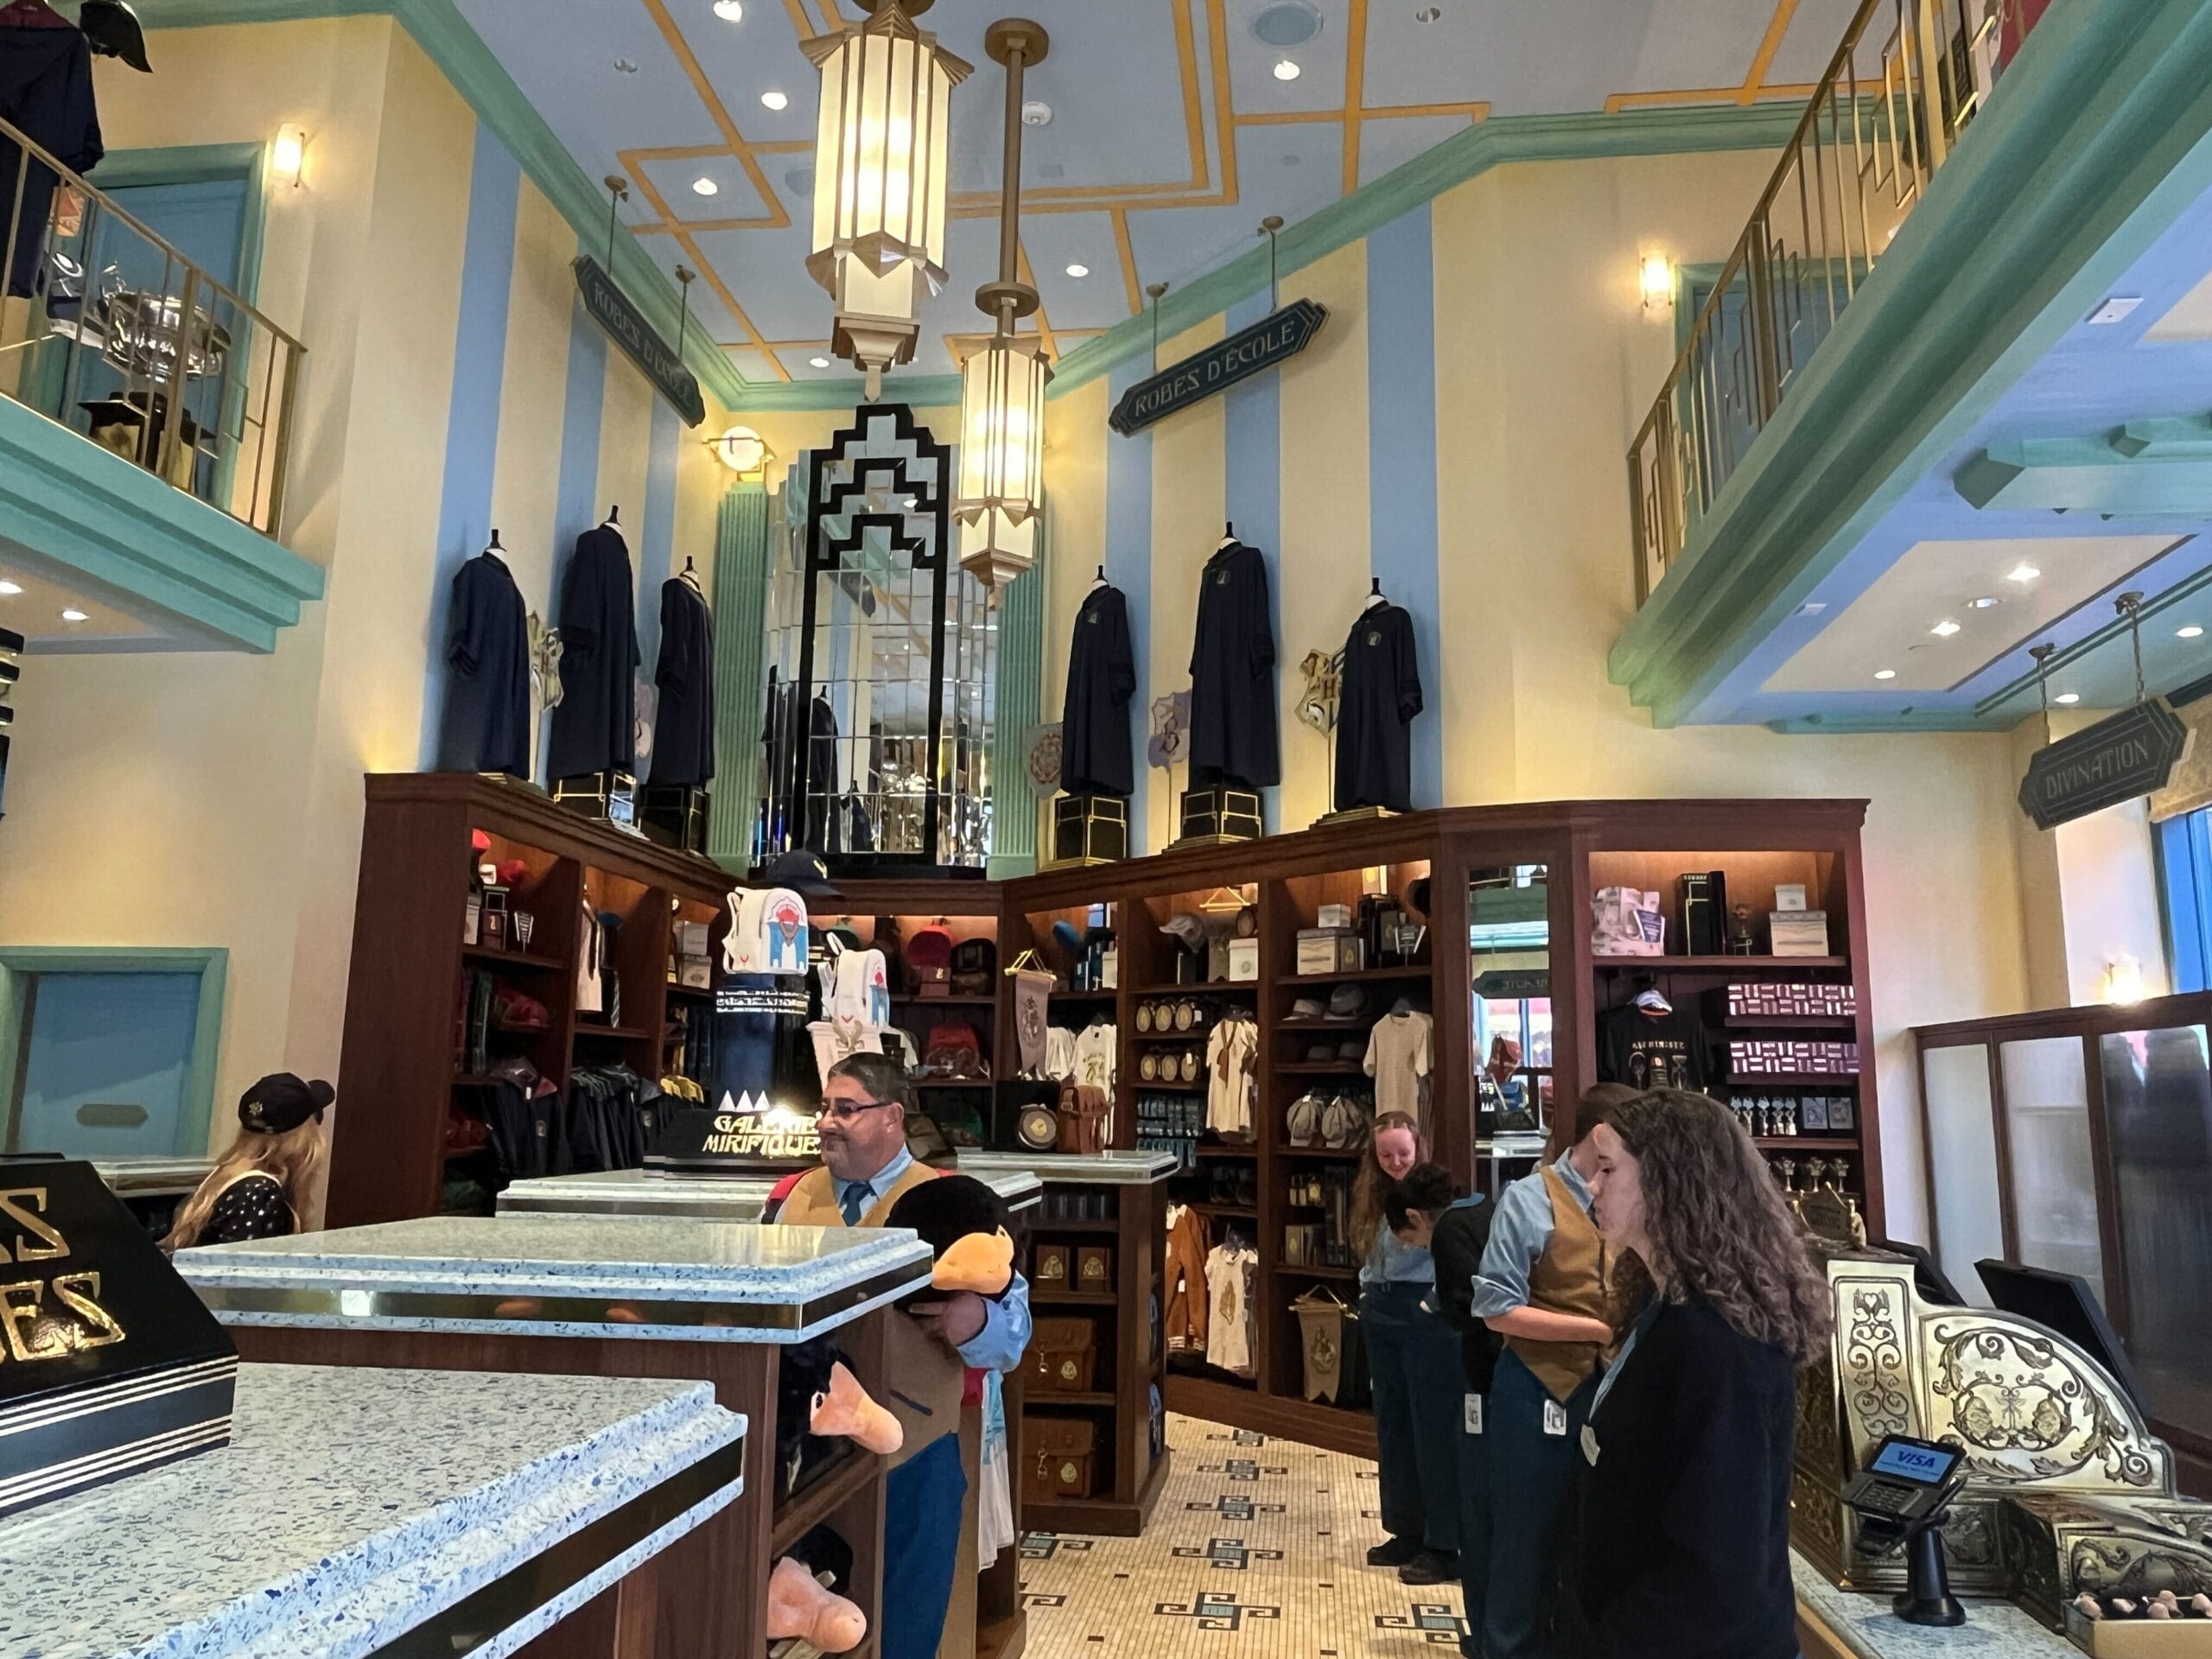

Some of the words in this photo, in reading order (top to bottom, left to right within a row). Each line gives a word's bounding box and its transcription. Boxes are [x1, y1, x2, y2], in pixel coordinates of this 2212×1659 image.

[1135, 367, 1200, 417] ROBES
[2045, 735, 2149, 800] DIVINATION
[702, 1134, 822, 1159] MIRIFIQUE
[1897, 1450, 1936, 1469] VISA
